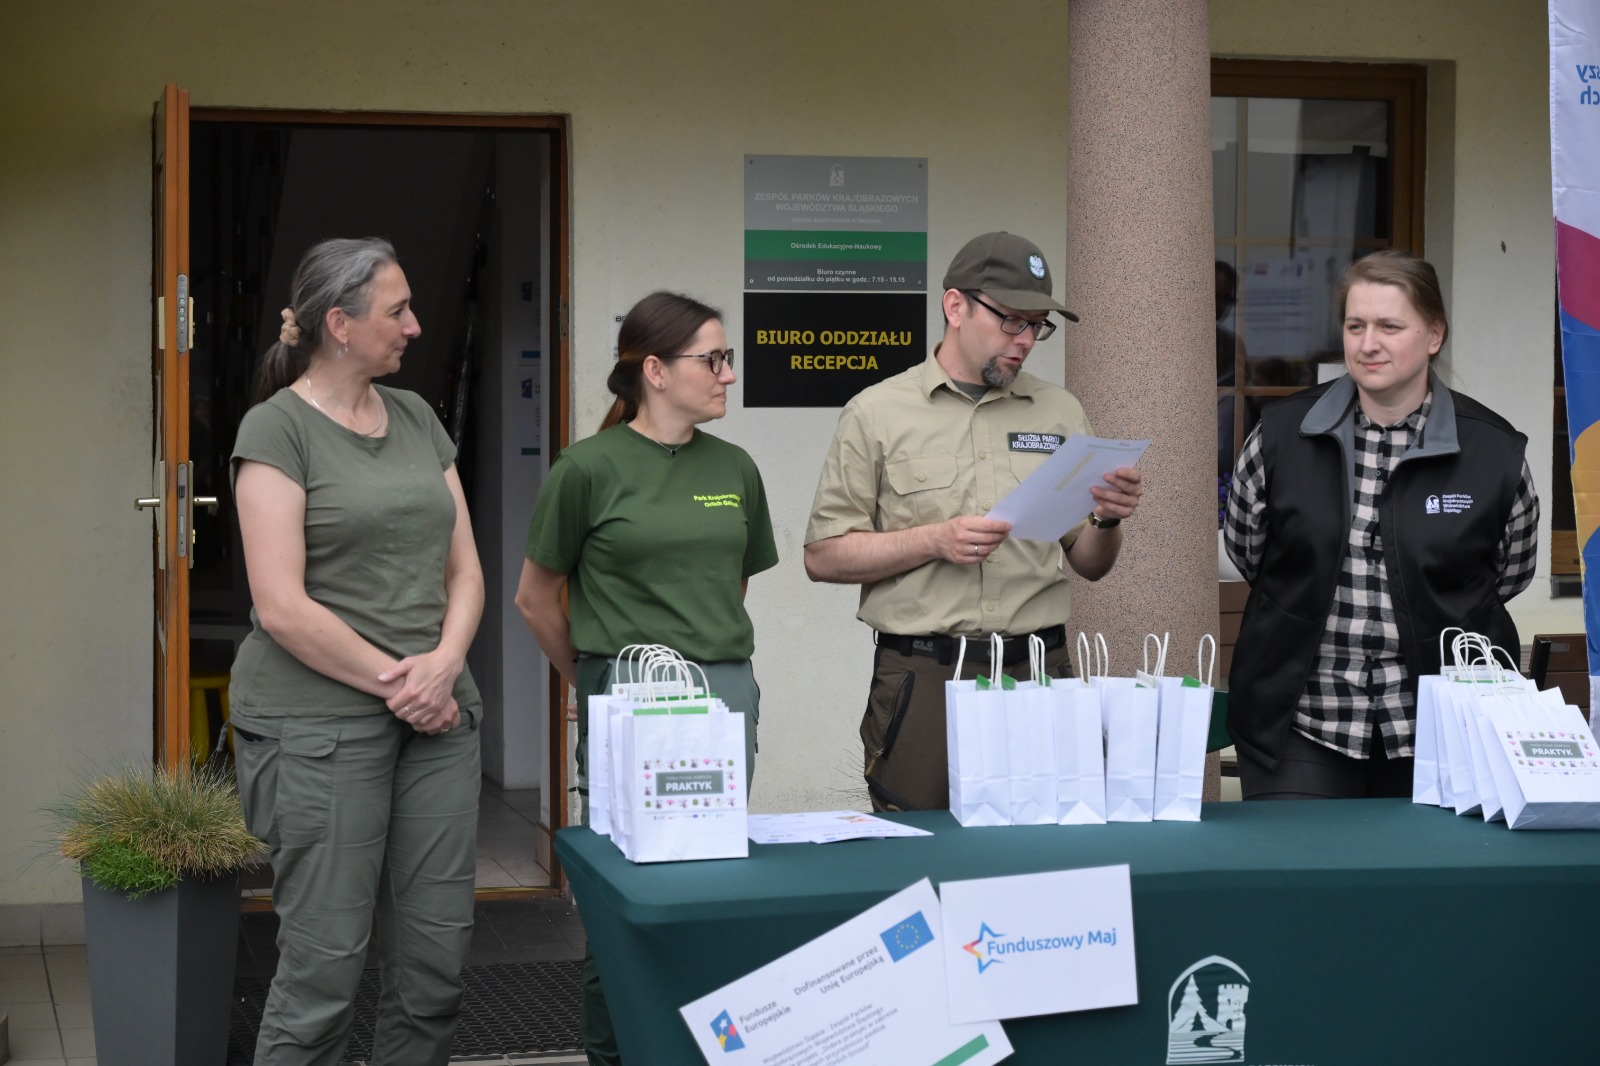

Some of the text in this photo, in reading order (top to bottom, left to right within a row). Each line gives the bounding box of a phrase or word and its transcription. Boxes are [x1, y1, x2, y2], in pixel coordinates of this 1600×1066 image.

[754, 192, 918, 203] ZESPÓŁ PARKÓW KRAJOBRAZOWYCH
[776, 202, 898, 213] WOJEWÓDZTWA ŚLĄSKIEGO
[818, 242, 882, 250] Edukacyjno-Naukowy
[756, 330, 912, 346] BIURO ODDZIAŁU
[790, 355, 878, 370] RECEPCJA
[1532, 748, 1573, 756] PRAKTYK
[666, 781, 712, 792] PRAKTYK
[988, 928, 1117, 956] Funduszowy Maj
[793, 946, 878, 995] Dofinansowane przez
[820, 956, 884, 994] Unię Europejską
[739, 1001, 776, 1024] Fundusze
[744, 1006, 790, 1033] Europejskie
